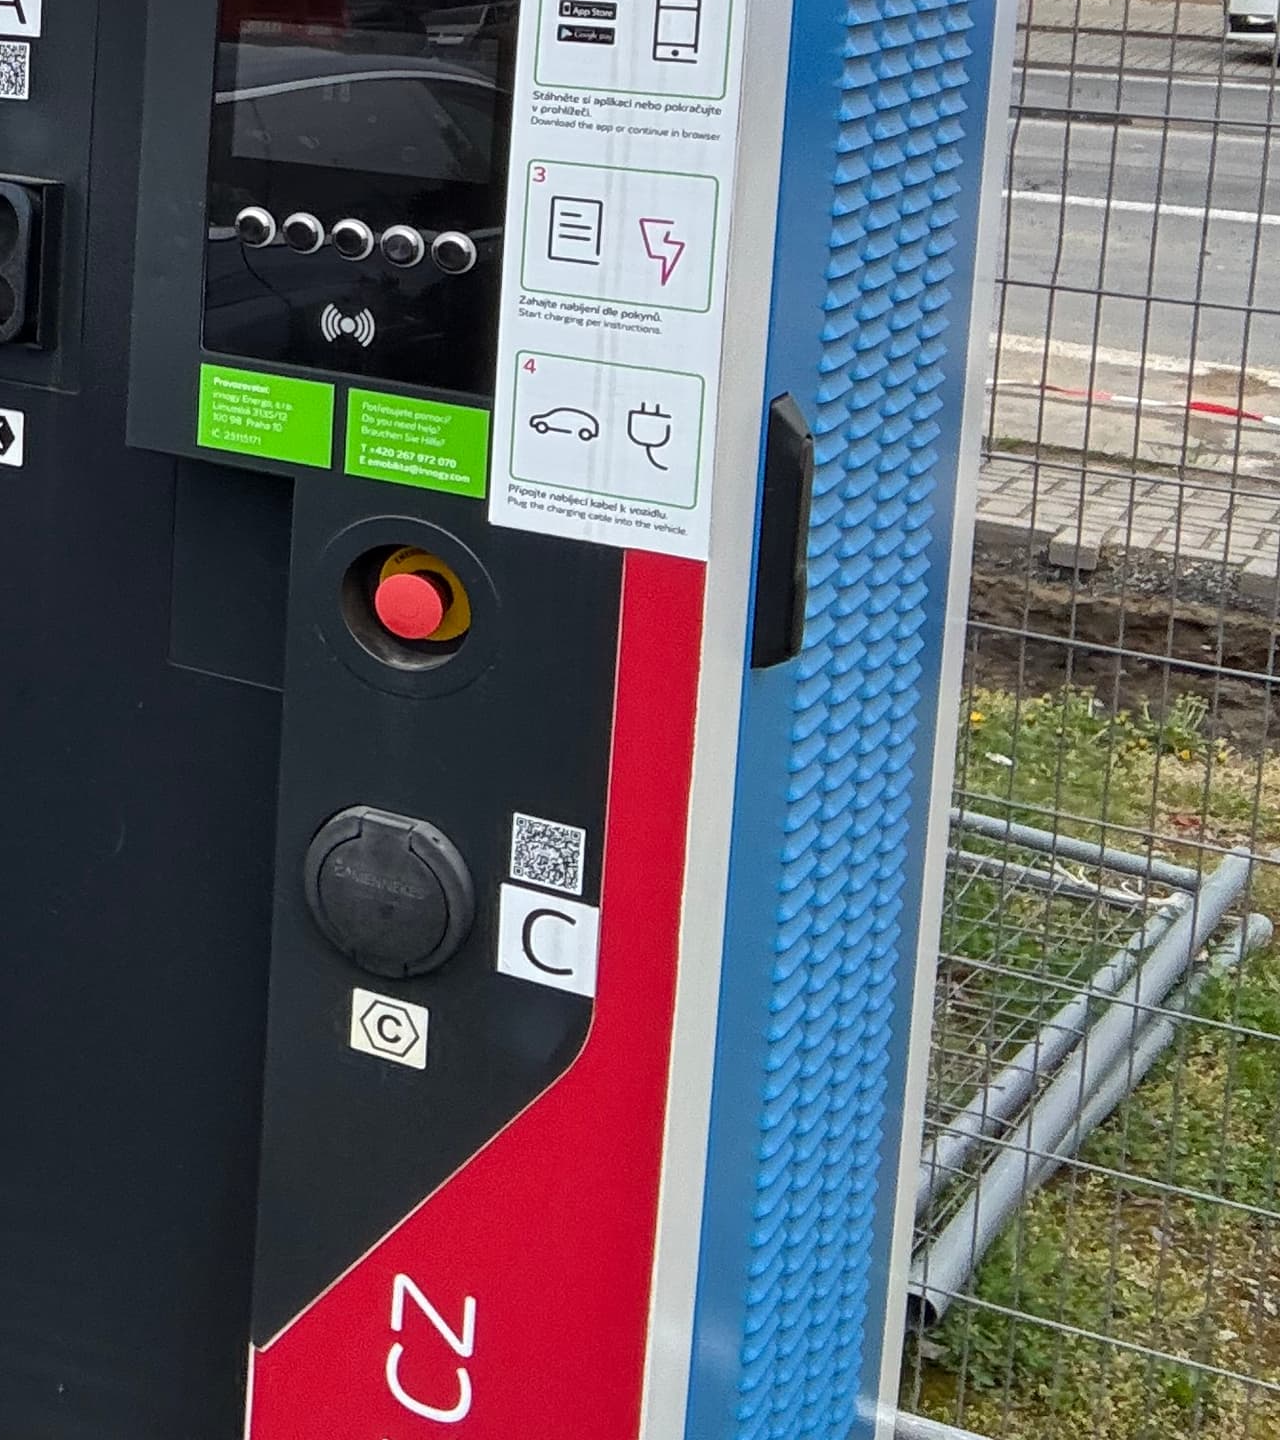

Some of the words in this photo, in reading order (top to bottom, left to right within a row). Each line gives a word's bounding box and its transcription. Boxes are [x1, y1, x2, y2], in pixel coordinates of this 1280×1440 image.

[573, 6, 590, 17] App
[592, 7, 614, 18] Store
[532, 90, 579, 104] Stáhněte
[593, 95, 632, 109] aplikaci
[634, 99, 662, 111] nebo
[663, 101, 722, 118] pokračujte
[530, 115, 576, 129] Download
[577, 120, 593, 130] the
[595, 123, 613, 133] app
[615, 125, 624, 133] or
[627, 125, 668, 137] continue
[671, 128, 679, 137] in
[681, 128, 720, 141] browser
[533, 166, 547, 183] 3
[518, 308, 542, 319] Start
[543, 311, 584, 326] charging
[585, 317, 601, 328] per
[603, 319, 662, 335] instructions.
[519, 294, 557, 310] Zahajte
[559, 300, 600, 316] nabíjení
[602, 306, 618, 316] dle
[621, 307, 662, 324] pokynů.
[523, 358, 537, 375] 4
[245, 417, 270, 430] Praha
[272, 422, 282, 432] 10
[361, 413, 374, 423] Do
[375, 417, 392, 428] you
[393, 419, 416, 430] need
[417, 422, 441, 435] help?
[359, 455, 366, 464] E
[360, 443, 366, 452] T
[369, 444, 394, 457] +420
[396, 449, 415, 461] 267
[416, 452, 436, 465] 972
[437, 456, 456, 469] 070
[507, 483, 546, 500] Připojte
[590, 498, 617, 511] kabel
[619, 503, 626, 513] k
[629, 504, 667, 520] vozidlu.
[507, 496, 527, 508] Plug
[529, 499, 544, 511] the
[546, 503, 586, 519] charging
[587, 510, 612, 523] cable
[614, 515, 632, 526] into
[634, 518, 651, 529] the
[521, 908, 577, 976] C
[376, 1013, 403, 1045] C
[385, 1272, 477, 1424] CZ
